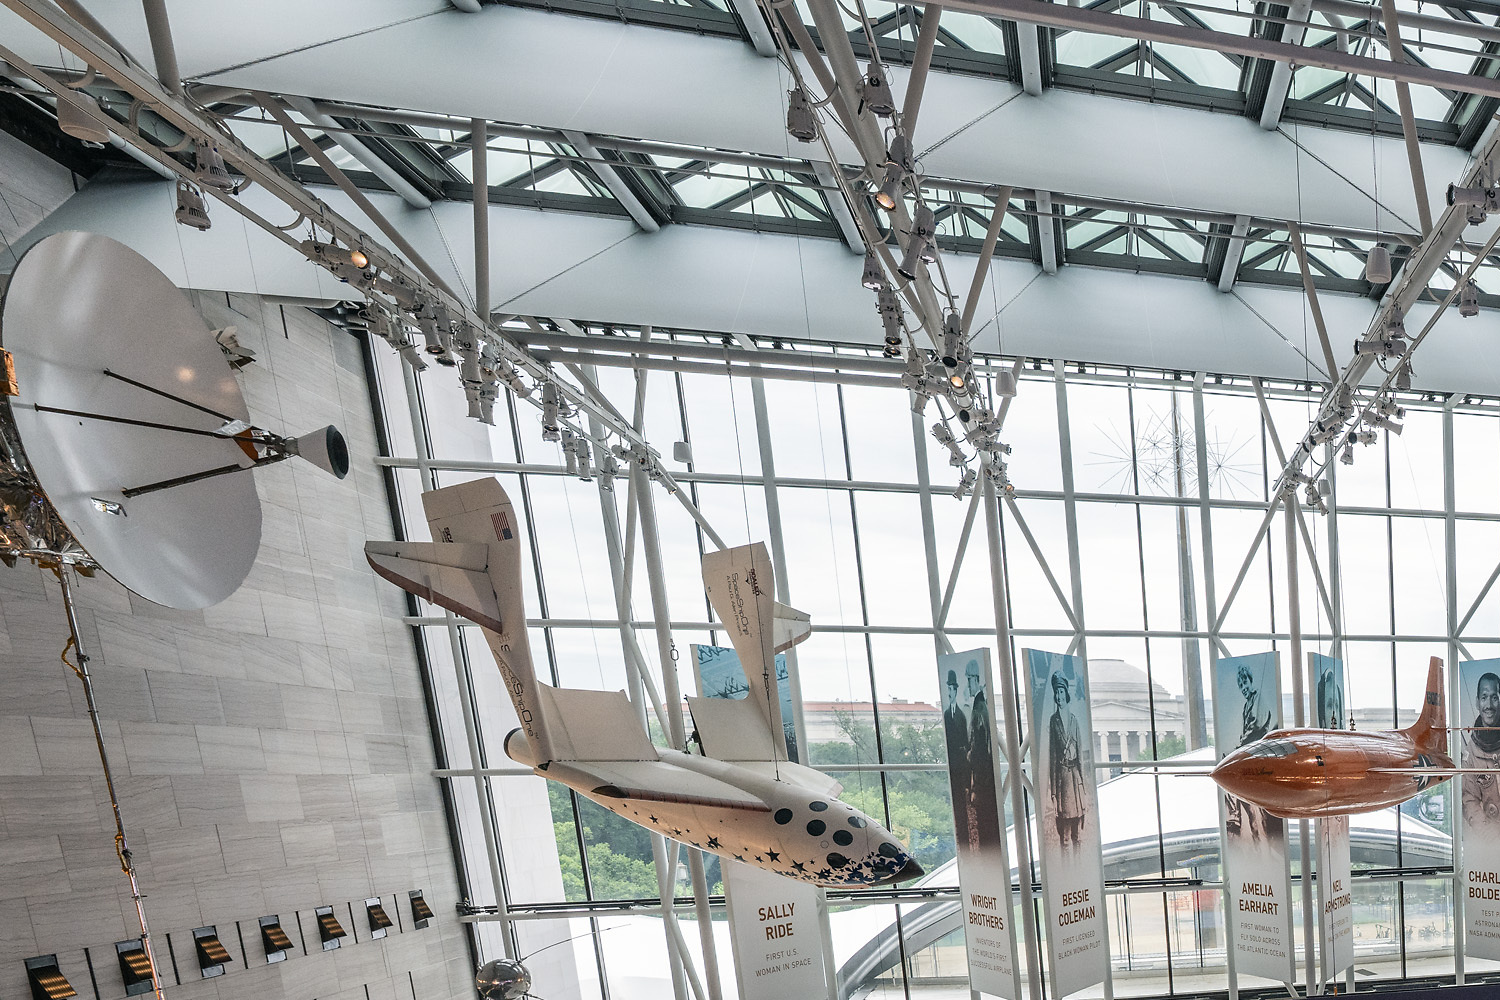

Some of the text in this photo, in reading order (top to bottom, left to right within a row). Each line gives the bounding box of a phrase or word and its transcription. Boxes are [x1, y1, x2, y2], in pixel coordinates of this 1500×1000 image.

[732, 572, 749, 636] SpaceShipOne
[1062, 889, 1089, 907] BESSIE
[1242, 882, 1274, 897] AMELIA
[971, 894, 997, 910] WRIGHT
[1239, 899, 1278, 915] EARHART
[758, 902, 794, 921] SALLY
[1058, 906, 1096, 926] COLEMAN
[969, 912, 1004, 930] BROTHERS
[1254, 924, 1272, 932] WOMAN
[766, 923, 794, 940] RIDE
[766, 948, 799, 961] FIRST U.S.
[1247, 946, 1268, 955] ATLANTIC
[1270, 950, 1285, 958] OCEAN
[756, 964, 780, 977] WOMAN
[792, 958, 812, 969] SPACE
